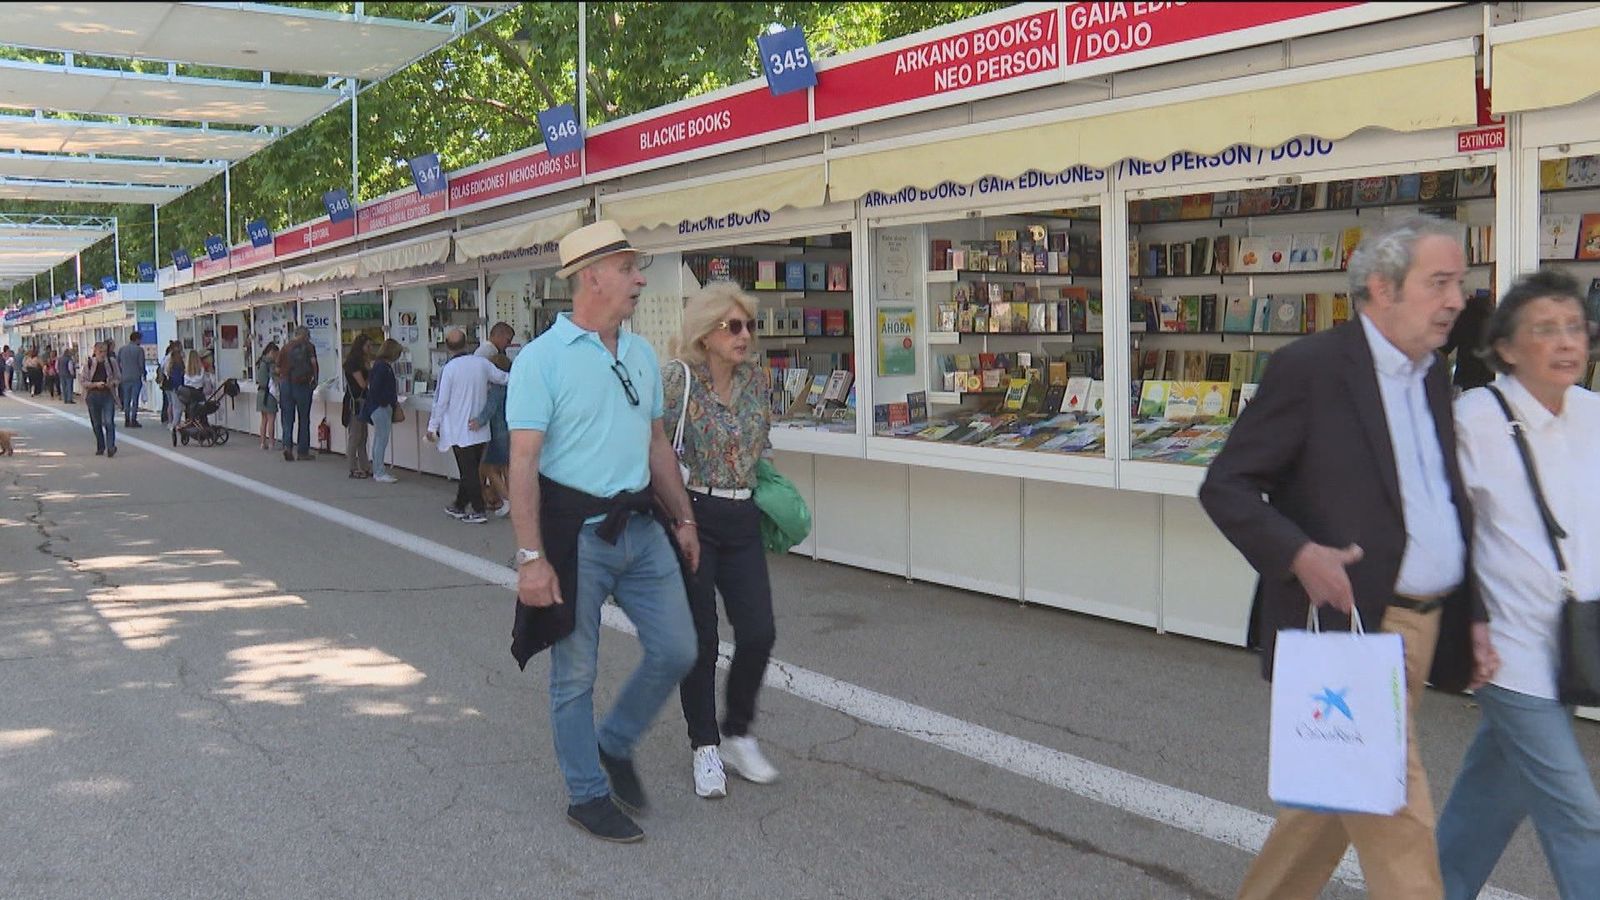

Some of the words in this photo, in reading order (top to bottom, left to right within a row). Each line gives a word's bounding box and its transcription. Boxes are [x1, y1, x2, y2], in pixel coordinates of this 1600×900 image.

[1071, 3, 1128, 30] GAIA
[894, 38, 969, 76] ARKANO
[973, 19, 1042, 54] BOOKS
[1047, 13, 1055, 41] /
[1073, 35, 1081, 63] /
[1087, 22, 1152, 58] DOJO
[769, 47, 808, 77] 345
[934, 64, 972, 92] NEO
[976, 43, 1057, 81] PERSON
[547, 119, 577, 142] 346
[640, 123, 686, 150] BLACKIE
[688, 110, 731, 138] BOOKS
[1460, 132, 1503, 149] EXTINTOR
[1118, 160, 1124, 181] /
[1129, 158, 1166, 176] NEO
[1171, 144, 1252, 171] PERSON
[1271, 138, 1333, 161] DOJO
[418, 165, 440, 183] 347
[450, 183, 470, 201] EOLAS
[470, 173, 504, 195] EDICIONES
[509, 158, 563, 185] MENOSLOBOS,
[564, 153, 579, 170] S.L.
[865, 185, 917, 208] ARKANO
[920, 182, 967, 201] BOOKS
[978, 176, 1015, 194] GAIA
[328, 198, 349, 215] 348
[251, 228, 269, 240] 349
[678, 215, 725, 234] BLACKIE
[727, 209, 770, 227] BOOKS
[208, 242, 224, 255] 350
[881, 321, 911, 334] AHORA
